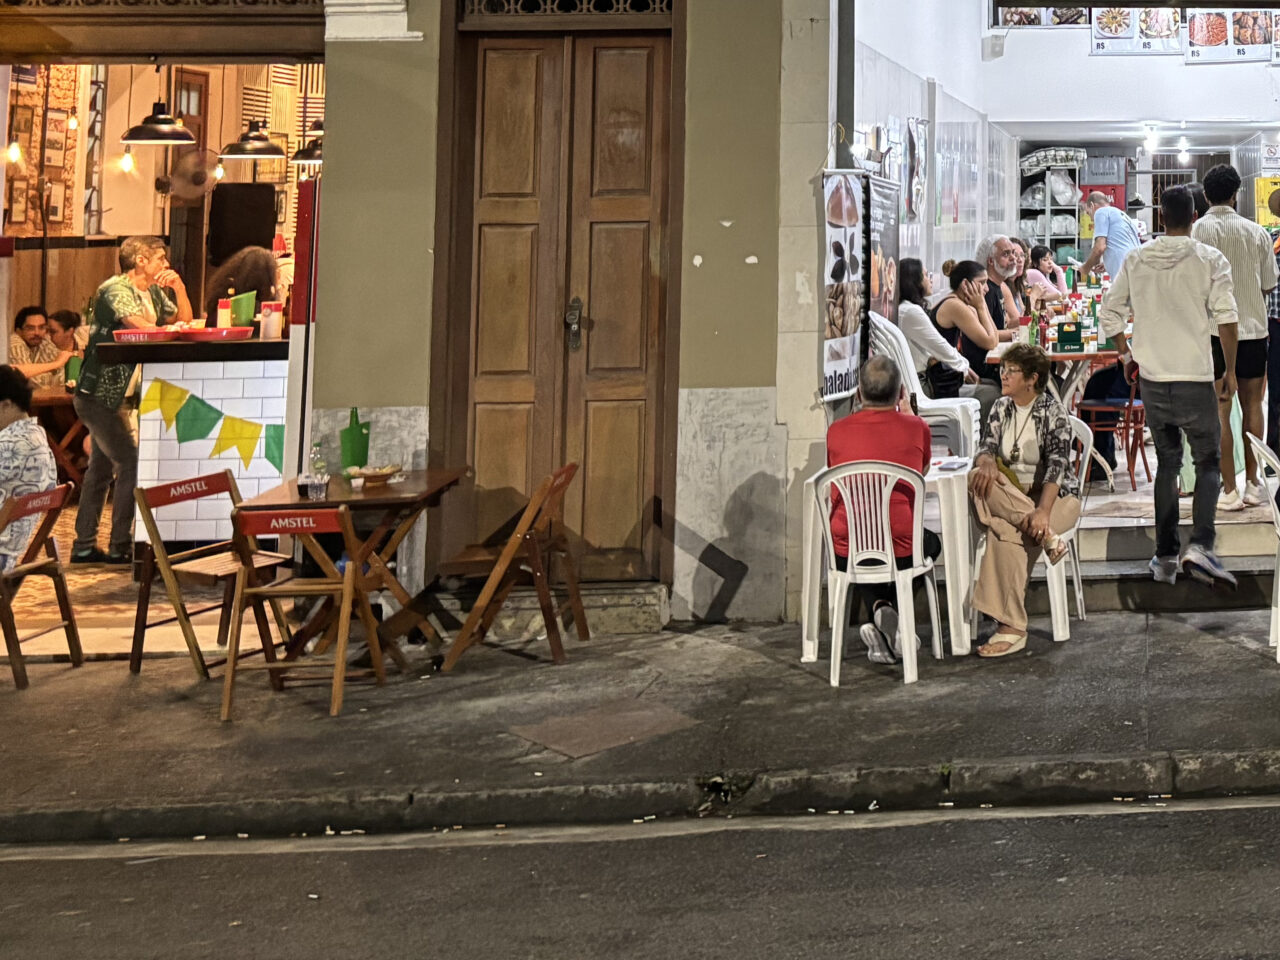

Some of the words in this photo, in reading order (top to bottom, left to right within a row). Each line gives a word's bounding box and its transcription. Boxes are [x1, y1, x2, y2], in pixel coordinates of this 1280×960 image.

[1096, 42, 1105, 51] R$
[1142, 41, 1151, 50] R$
[1191, 49, 1200, 58] R$
[1236, 48, 1246, 56] R$
[170, 481, 208, 497] AMSTEL
[270, 517, 316, 529] AMSTEL
